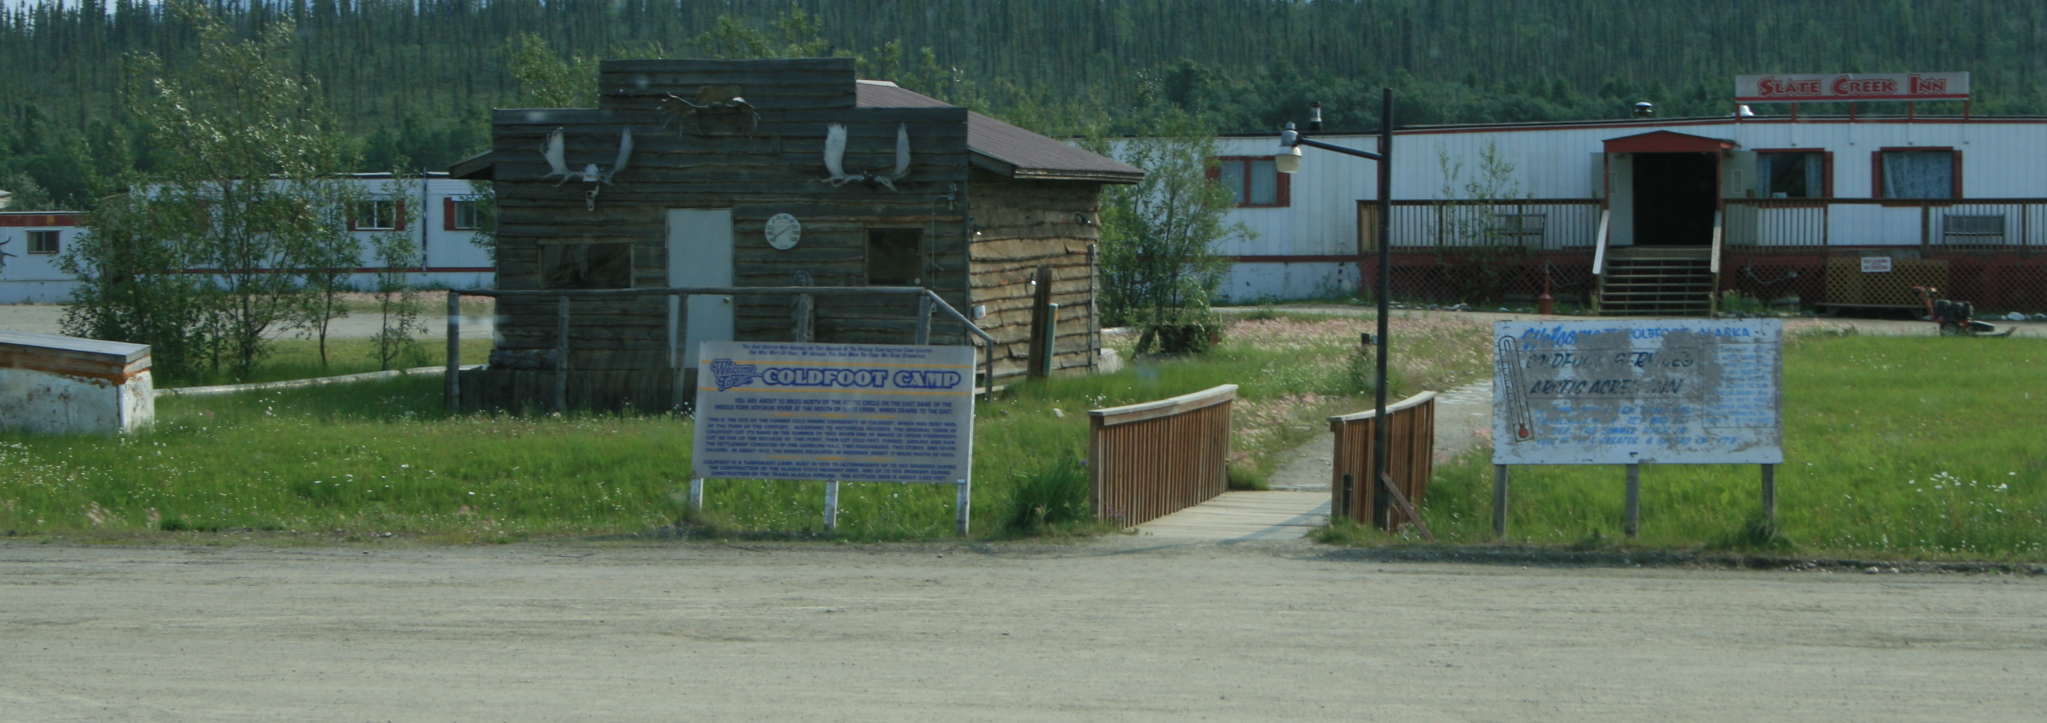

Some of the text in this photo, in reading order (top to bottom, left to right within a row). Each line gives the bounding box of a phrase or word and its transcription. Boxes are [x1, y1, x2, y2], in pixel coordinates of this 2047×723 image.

[1758, 74, 1946, 96] SLATE CREEK INN
[1522, 326, 1600, 349] Welco
[1628, 327, 1690, 339] OLDFO
[711, 359, 756, 378] Welcome
[762, 368, 961, 389] COLDFOOT CAMP
[1588, 379, 1639, 394] ACRE
